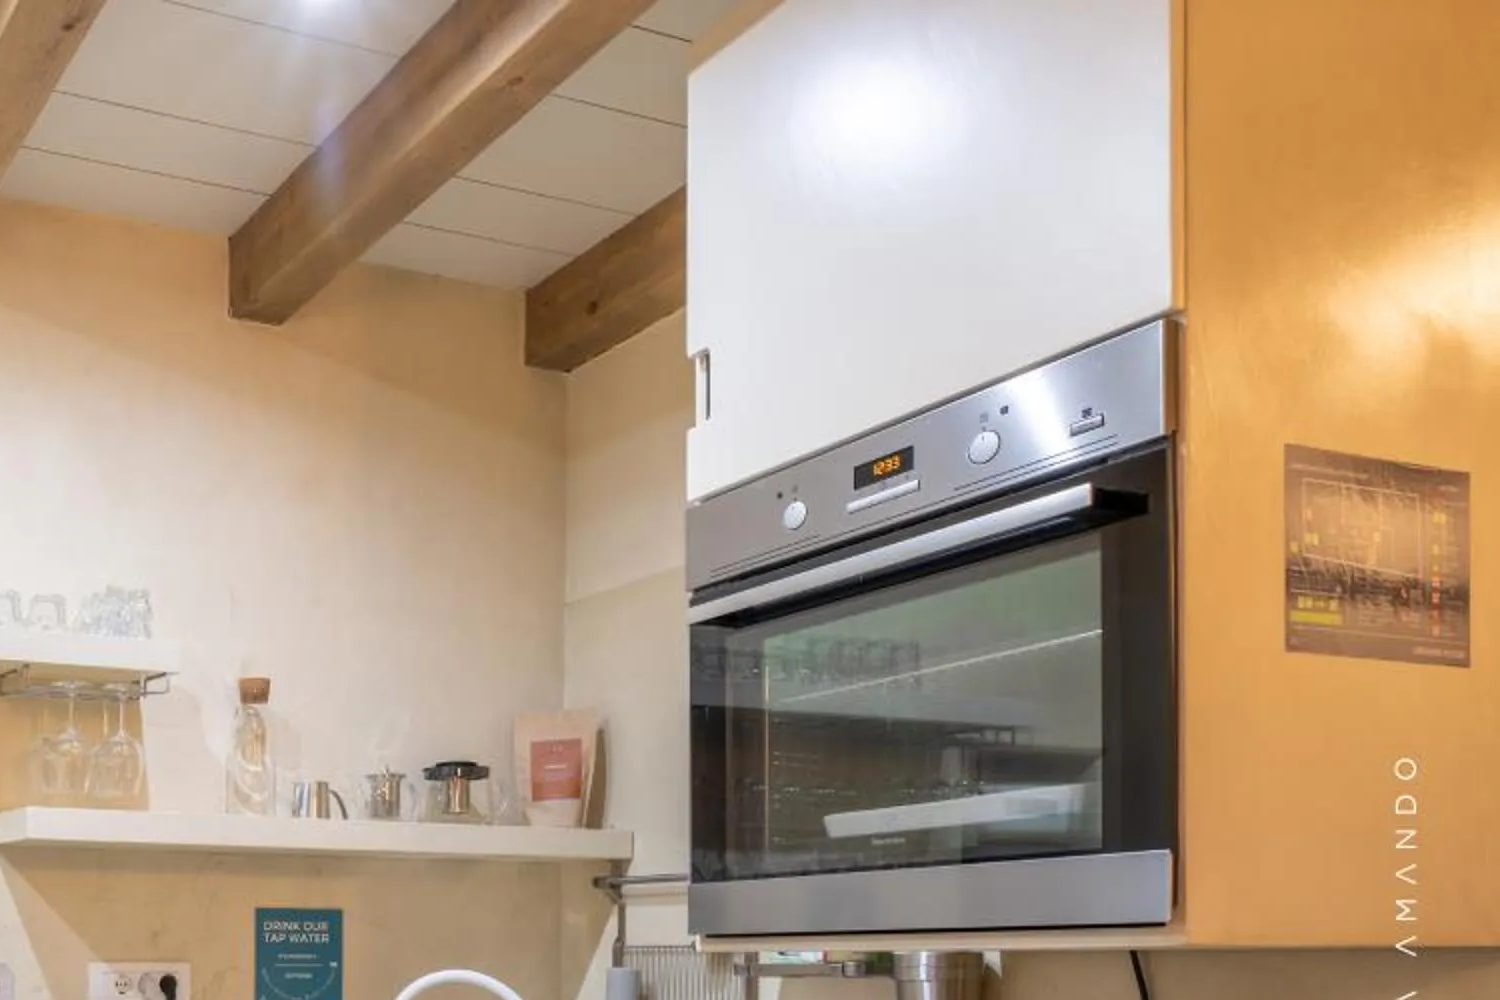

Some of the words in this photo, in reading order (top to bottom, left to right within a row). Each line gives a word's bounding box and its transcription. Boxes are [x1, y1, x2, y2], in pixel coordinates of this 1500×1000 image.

[263, 921, 301, 931] DRINK
[304, 921, 329, 931] OUR
[264, 933, 287, 943] TAP
[289, 933, 329, 943] WATER
